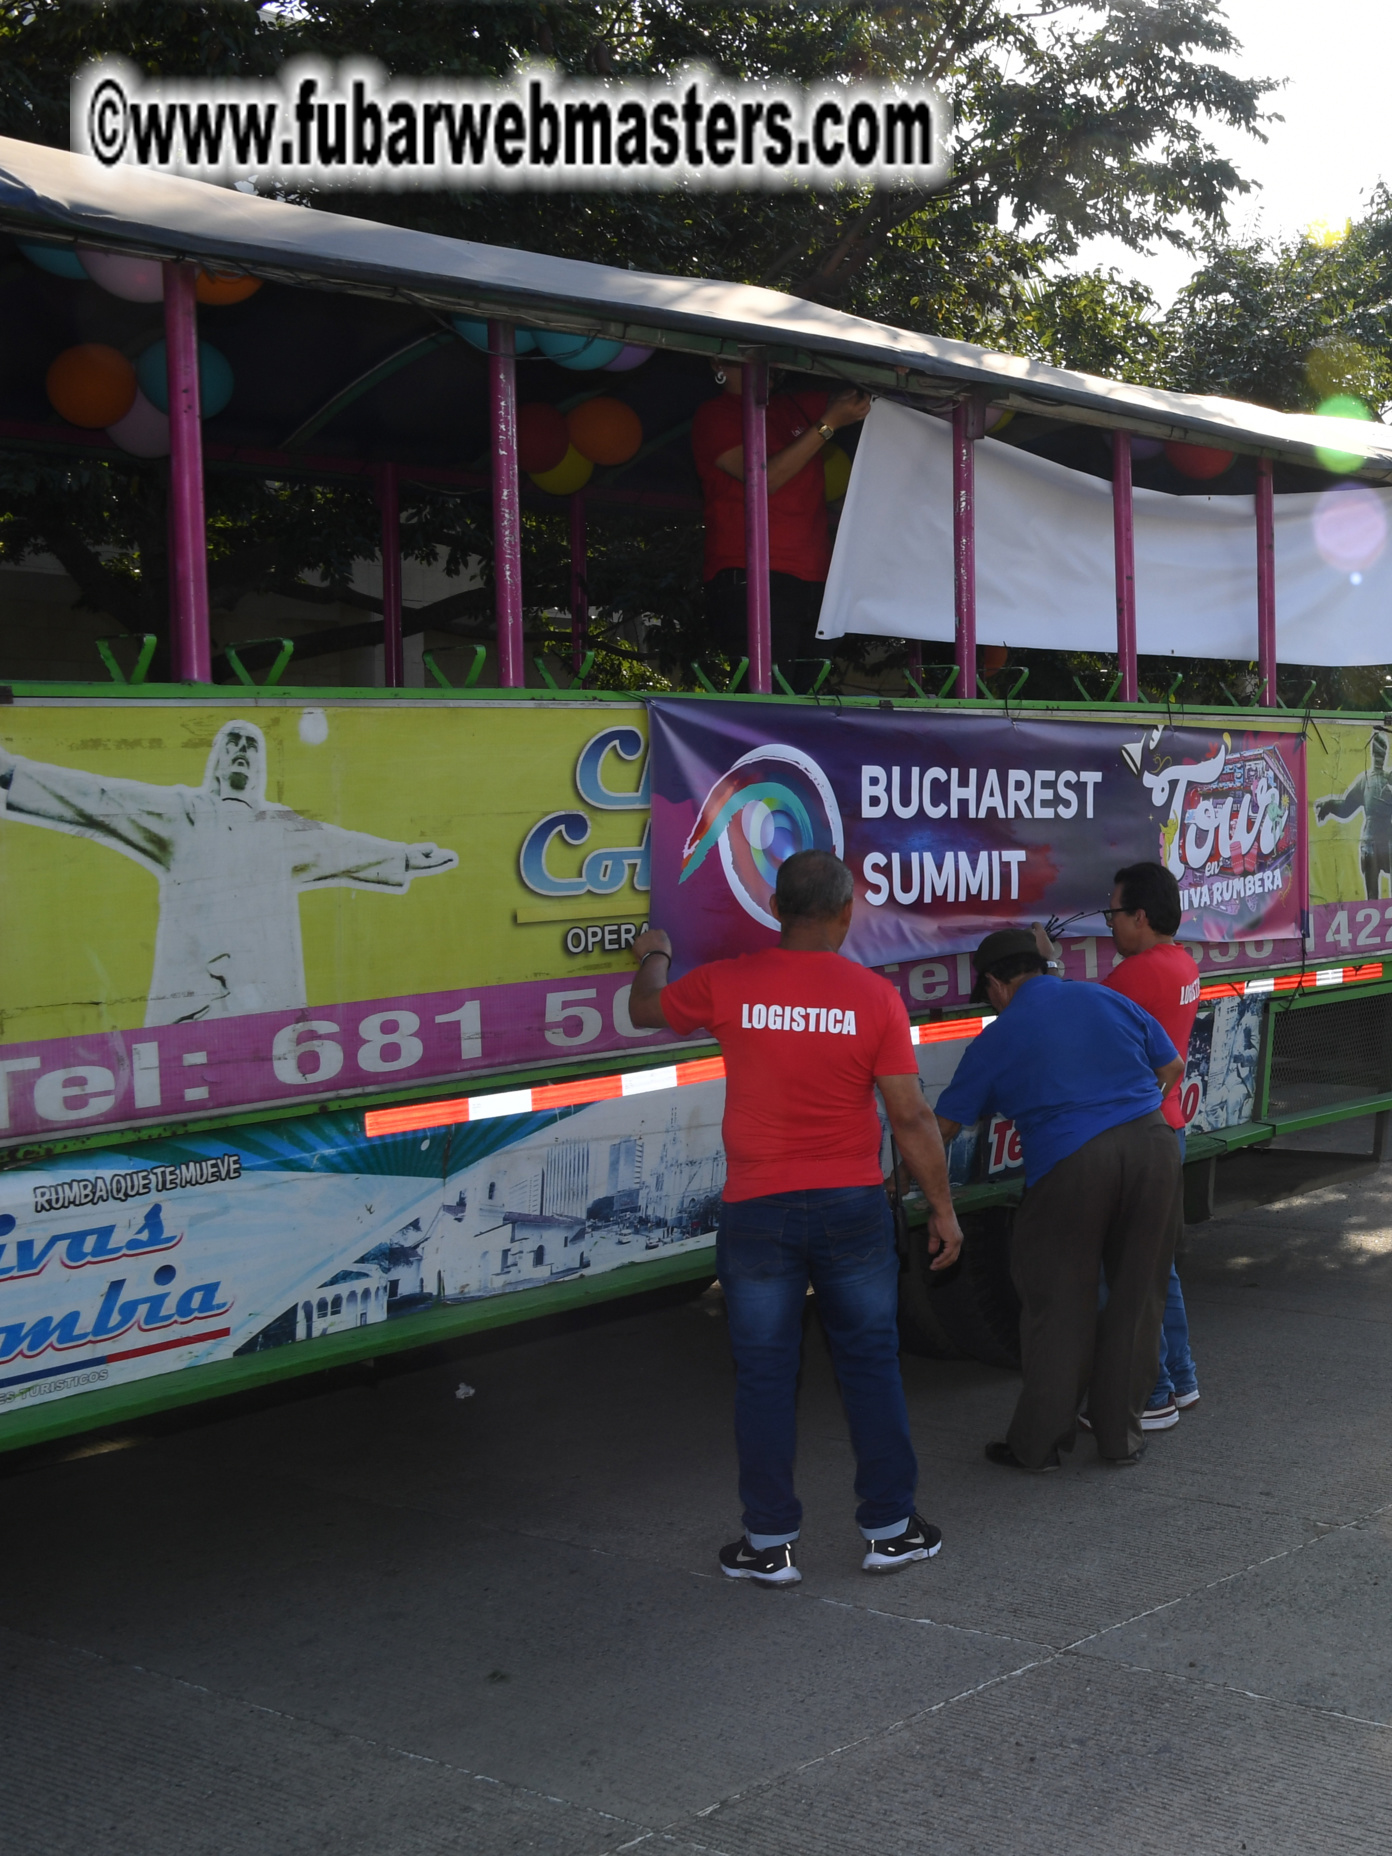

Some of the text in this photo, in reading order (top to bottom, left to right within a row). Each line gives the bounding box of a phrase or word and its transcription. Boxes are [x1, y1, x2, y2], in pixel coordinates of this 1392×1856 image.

[861, 765, 1103, 819] BUCHAREST
[1143, 745, 1289, 881] Tour
[863, 850, 1027, 906] SUMMIT
[1205, 861, 1221, 877] en
[1212, 869, 1283, 901] RUMBERA
[272, 1000, 485, 1085] 681
[742, 1003, 857, 1035] LOGISTICA
[35, 1155, 241, 1212] RUMBA QUE TE MUEVE
[18, 1369, 109, 1399] TURISTICOS
